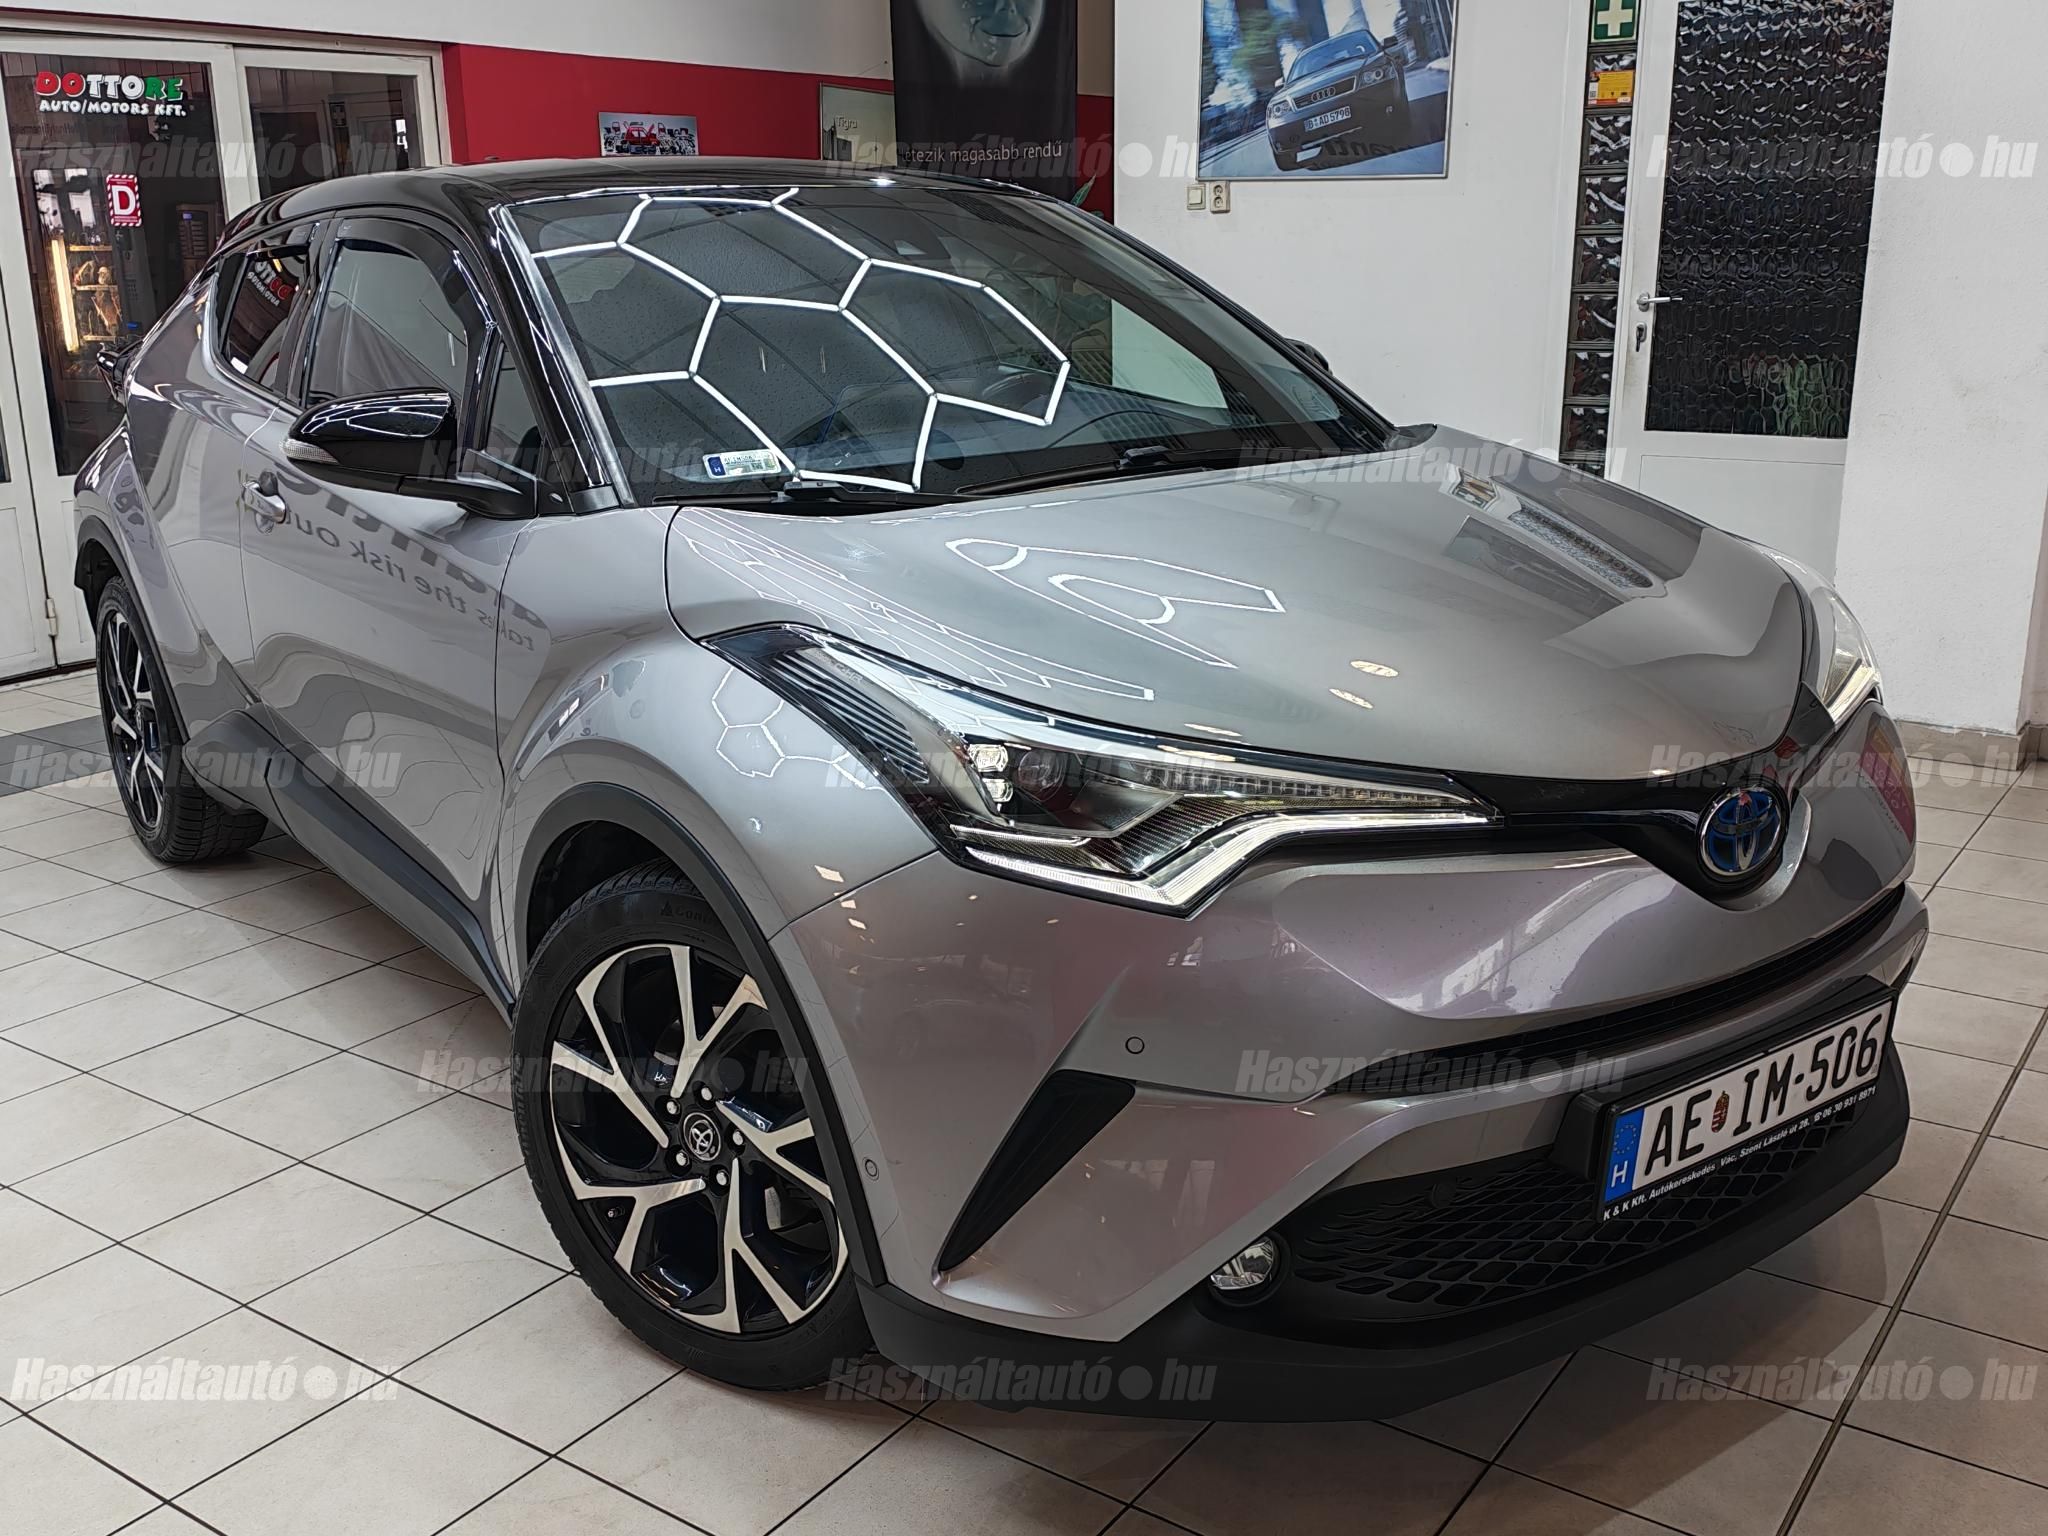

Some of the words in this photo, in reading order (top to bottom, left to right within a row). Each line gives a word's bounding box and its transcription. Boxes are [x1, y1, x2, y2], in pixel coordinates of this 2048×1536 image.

[36, 71, 183, 101] DOTTORE
[39, 99, 149, 114] AUTO/MOTORS
[154, 103, 187, 117] KFT.
[950, 143, 1019, 165] magasabb
[1022, 140, 1062, 159] rendű
[112, 185, 136, 215] D
[1644, 1089, 1712, 1176] AE
[1603, 1208, 1611, 1221] K
[1612, 1205, 1620, 1216] &
[1622, 1200, 1630, 1212] K
[1631, 1195, 1647, 1208] Kft.
[1648, 1162, 1716, 1200] Autókereskedés
[1740, 1141, 1762, 1158] Szent
[1763, 1129, 1789, 1147] László
[1611, 1160, 1628, 1188] H
